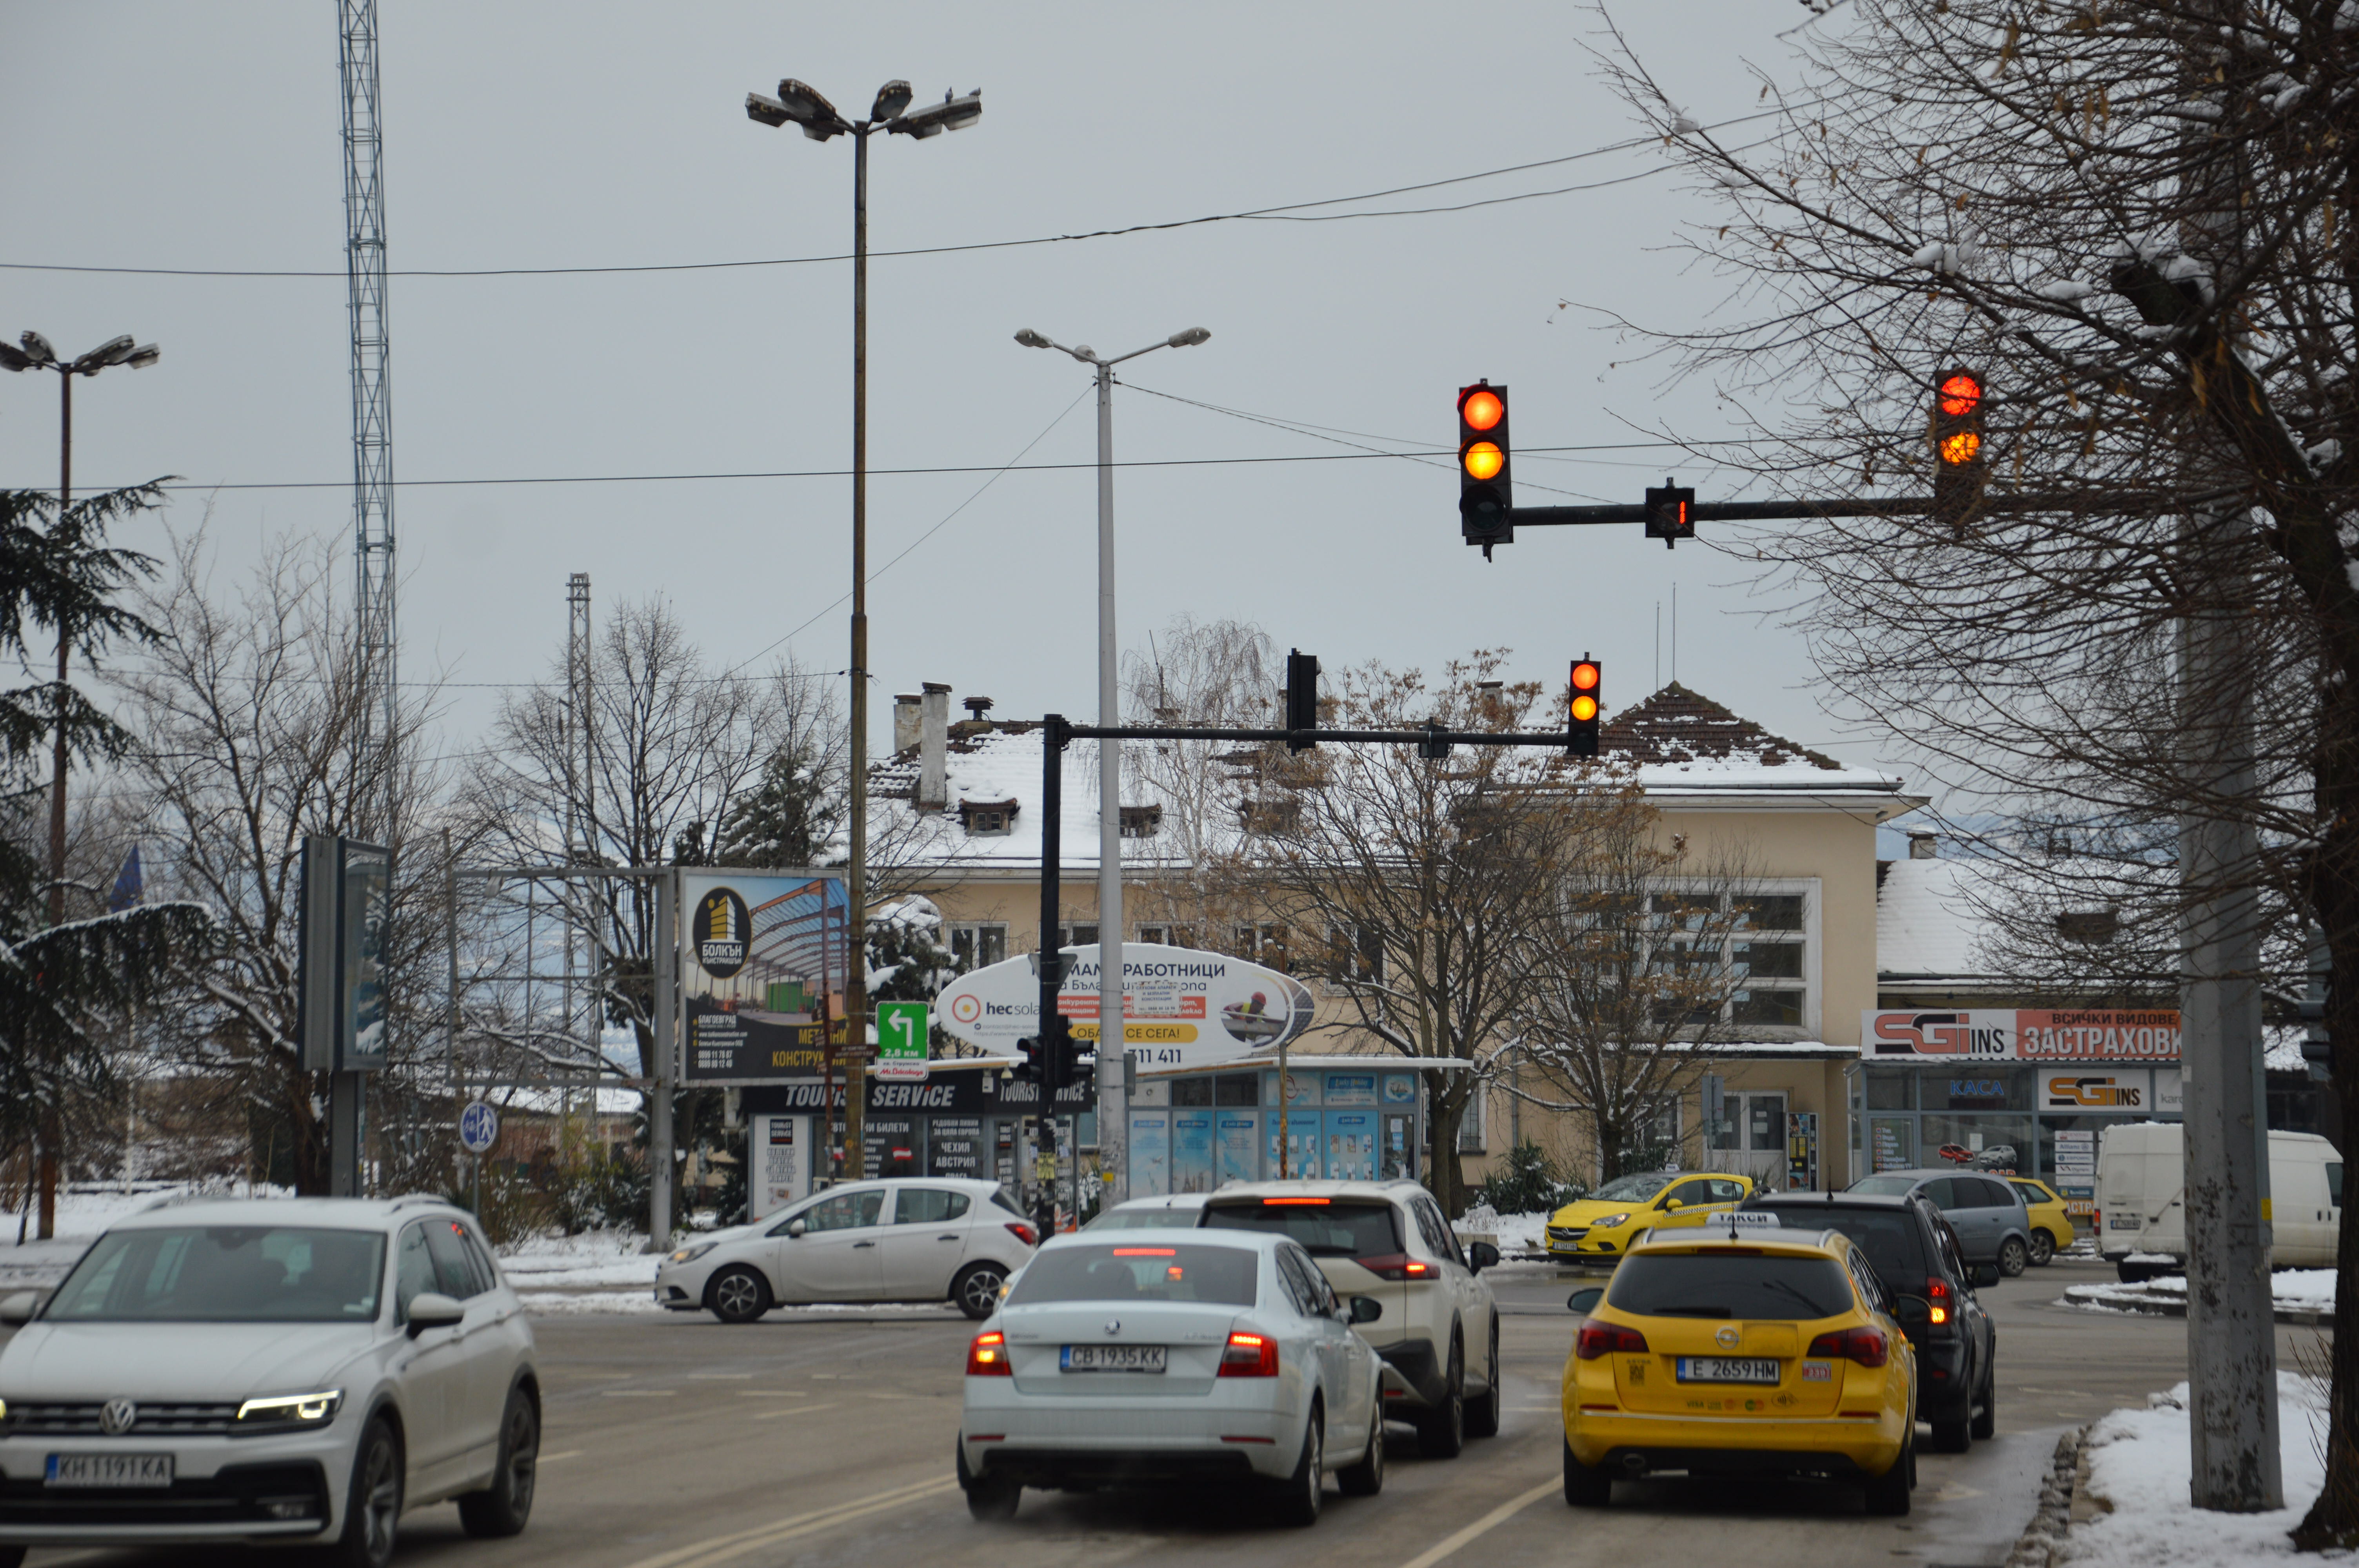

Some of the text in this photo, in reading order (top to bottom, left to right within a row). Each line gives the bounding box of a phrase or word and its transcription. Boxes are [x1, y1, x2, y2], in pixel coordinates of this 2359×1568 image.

[702, 944, 742, 956] БОЛКЪН
[1123, 964, 1225, 978] РАБОТНИЦИ
[2052, 1013, 2175, 1025] ВСИЧКИ ВИДОВЕ
[1126, 1028, 1142, 1038] СЕ
[1146, 1028, 1180, 1038] СЕГА!
[2025, 1027, 2181, 1054] ЗАСТРАХОВК
[885, 1048, 901, 1058] 2,8
[1158, 1049, 1181, 1063] 411
[1950, 1080, 2005, 1096] КАСА
[877, 1122, 909, 1133] БИЛЕТИ
[941, 1142, 970, 1153] ЧЕХИЯ
[936, 1156, 976, 1168] АВСТРИЯ
